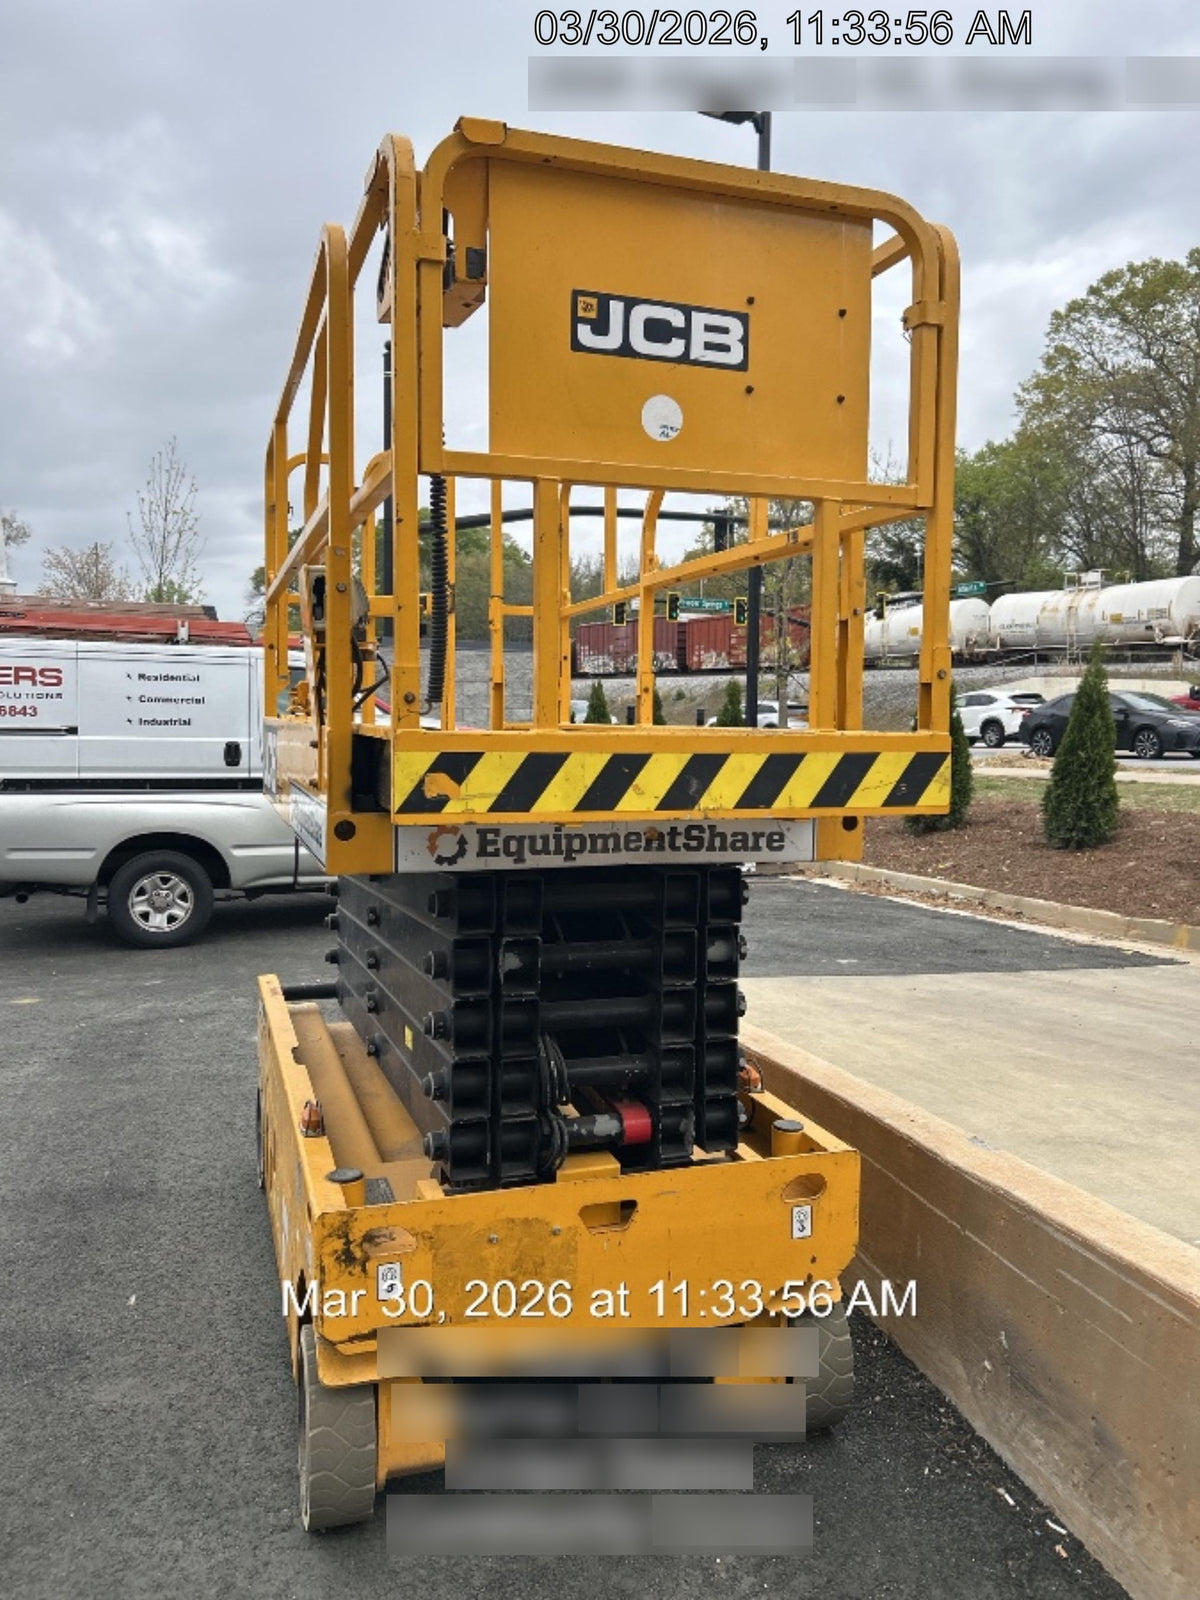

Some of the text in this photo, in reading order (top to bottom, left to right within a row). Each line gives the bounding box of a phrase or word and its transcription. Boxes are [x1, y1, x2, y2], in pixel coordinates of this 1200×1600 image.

[577, 300, 744, 365] JCB
[138, 673, 200, 682] Residential
[139, 694, 206, 705] Commercial
[138, 717, 192, 726] Industrial
[476, 825, 786, 864] EquipmentShare
